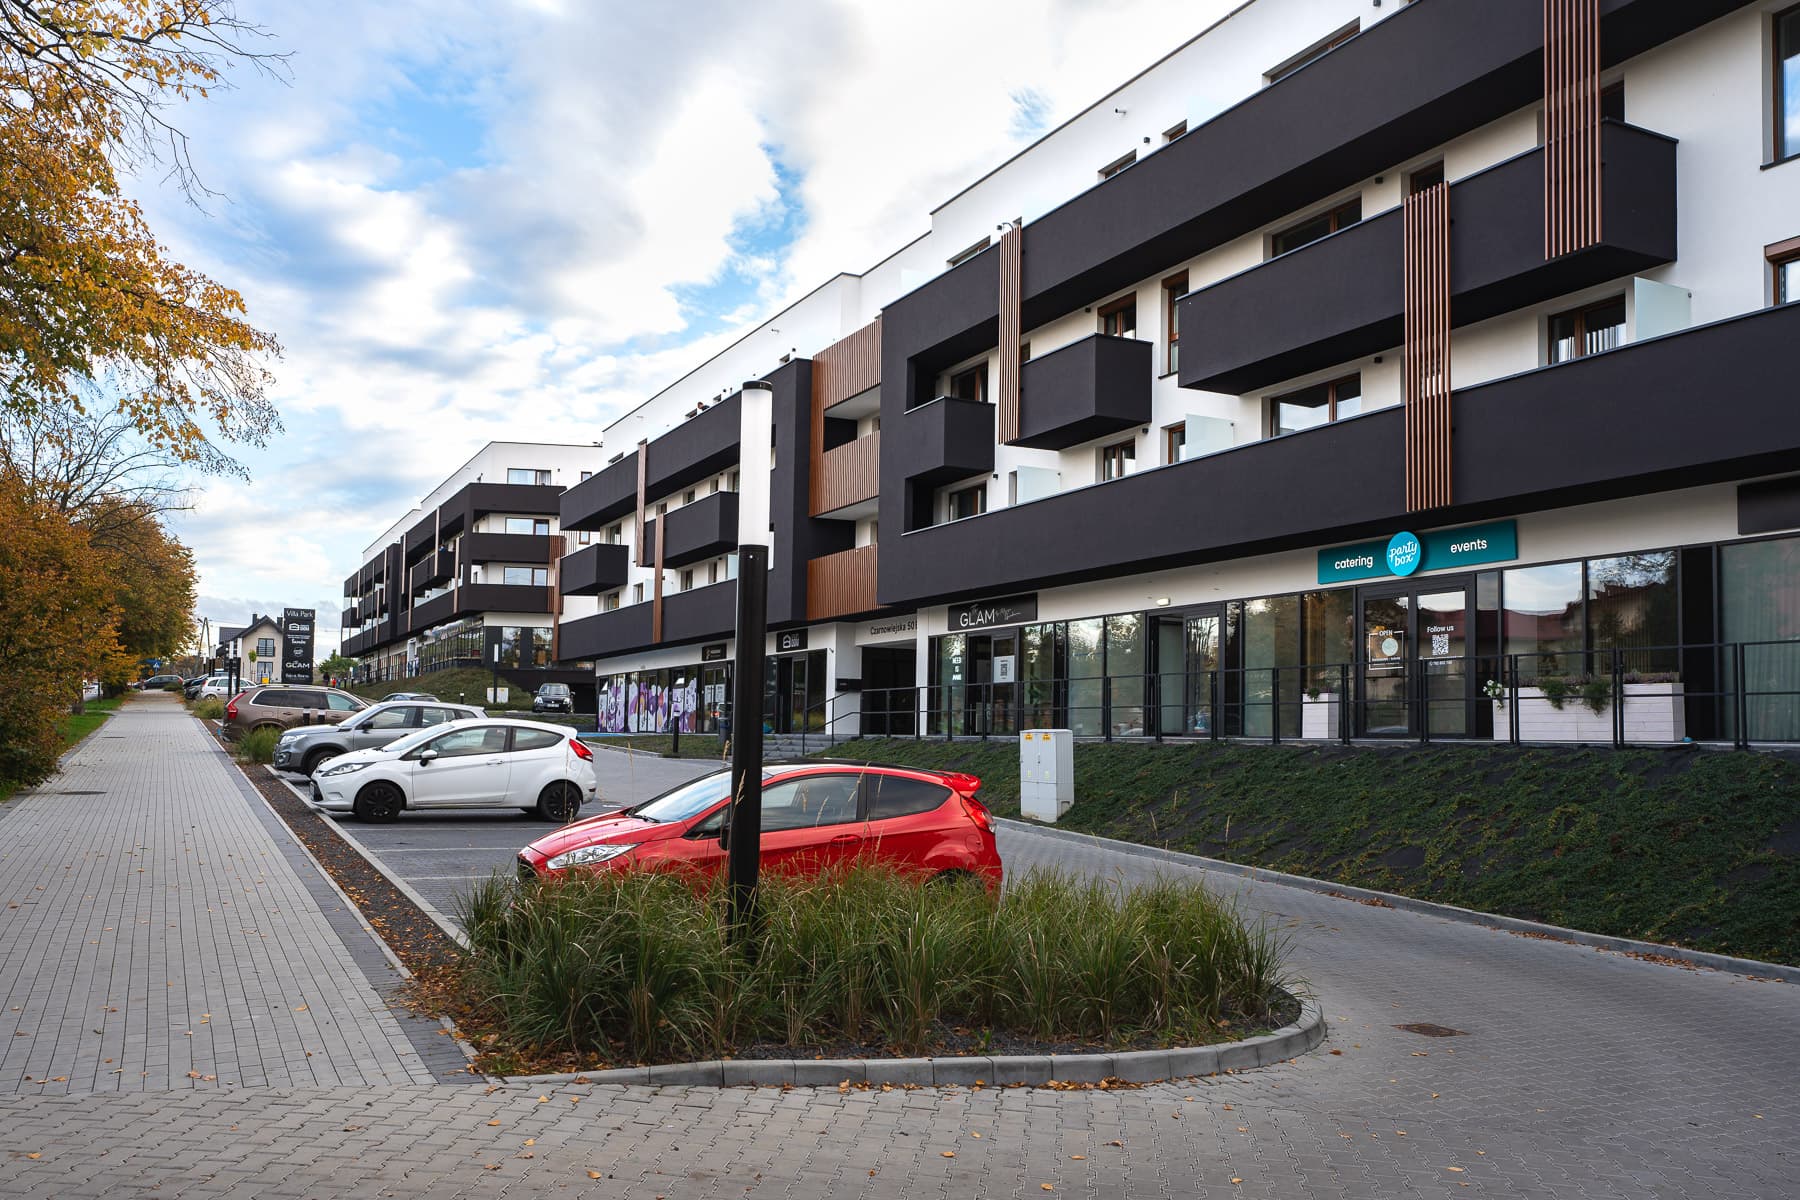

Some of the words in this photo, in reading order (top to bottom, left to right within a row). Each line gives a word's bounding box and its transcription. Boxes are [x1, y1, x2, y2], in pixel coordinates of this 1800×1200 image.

[1389, 541, 1418, 561] party
[1450, 538, 1487, 553] events
[1334, 555, 1373, 569] catering
[1394, 554, 1414, 567] box
[300, 610, 313, 618] Park
[959, 608, 995, 627] GLAM
[870, 622, 907, 636] Czarnowiejska
[907, 621, 915, 630] 50
